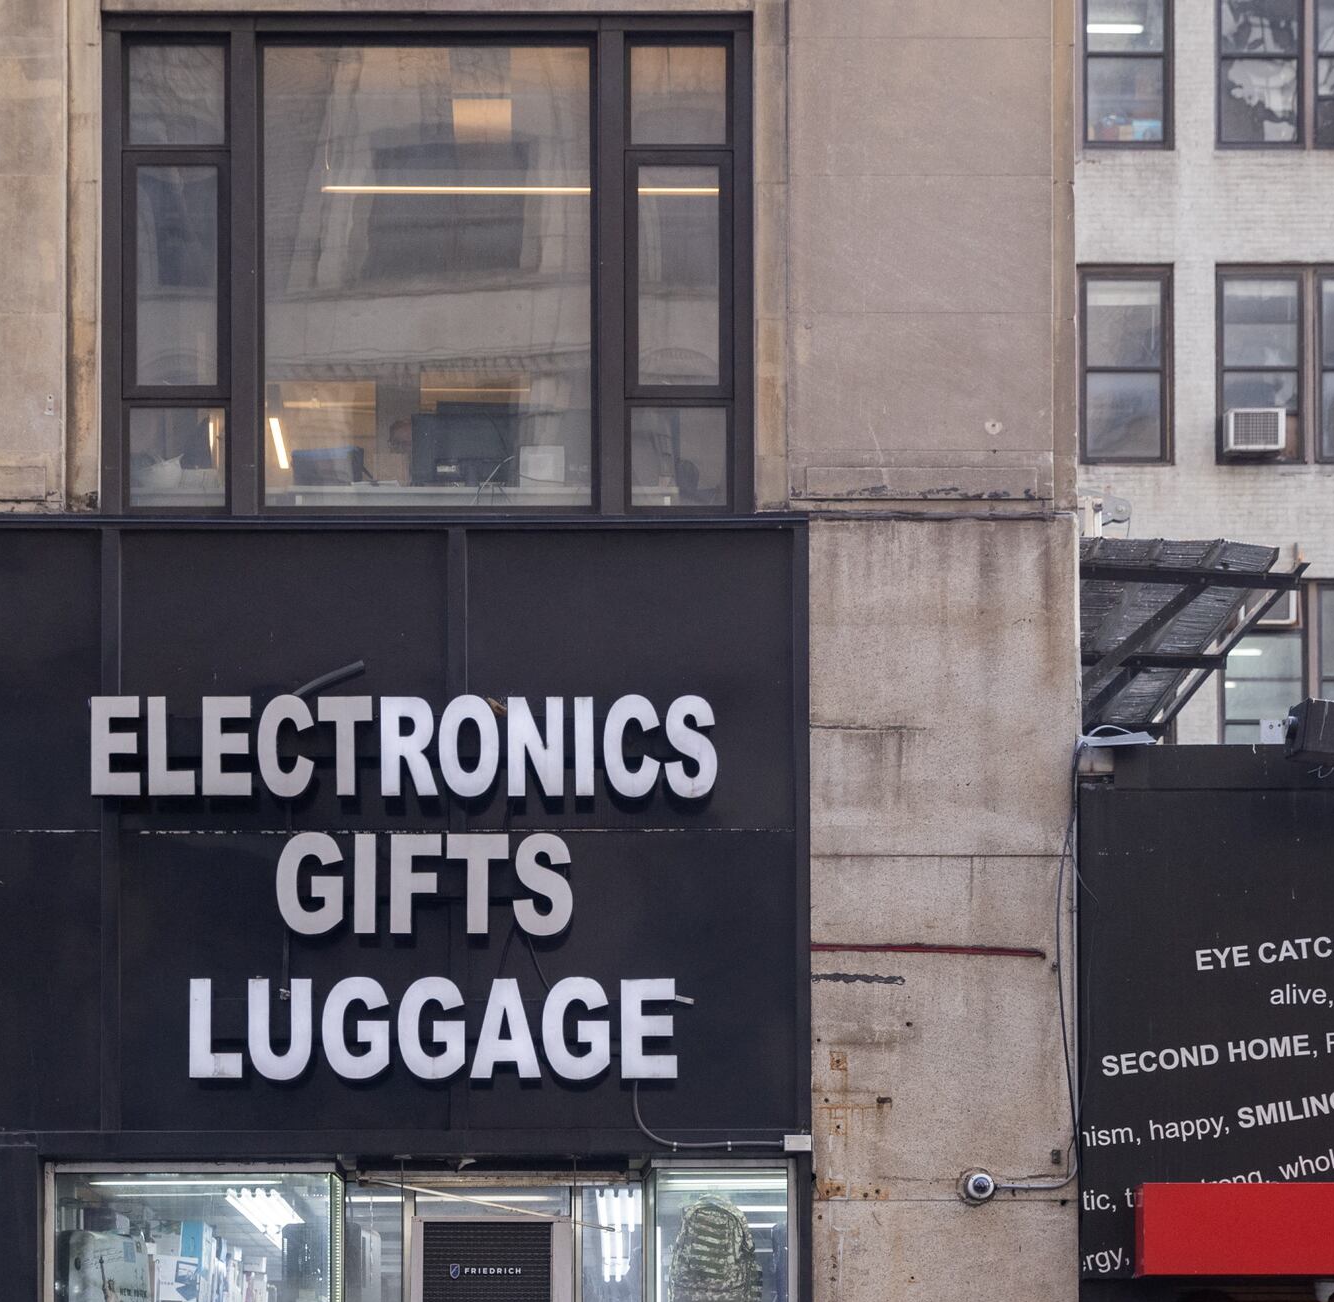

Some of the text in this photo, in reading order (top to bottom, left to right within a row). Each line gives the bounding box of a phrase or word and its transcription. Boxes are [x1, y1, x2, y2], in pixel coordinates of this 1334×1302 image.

[89, 694, 718, 798] ELECTRONICS
[276, 832, 573, 936] GIFTS
[1196, 945, 1250, 971] EYE
[1270, 984, 1334, 1008] alive,
[189, 976, 678, 1081] LUGGAGE
[1101, 1044, 1220, 1076] SECOND
[1227, 1034, 1318, 1063] HOME,
[1149, 1114, 1230, 1142] happy,
[464, 1267, 522, 1275] FRIEDRICH
[1083, 1247, 1130, 1273] rgy,
